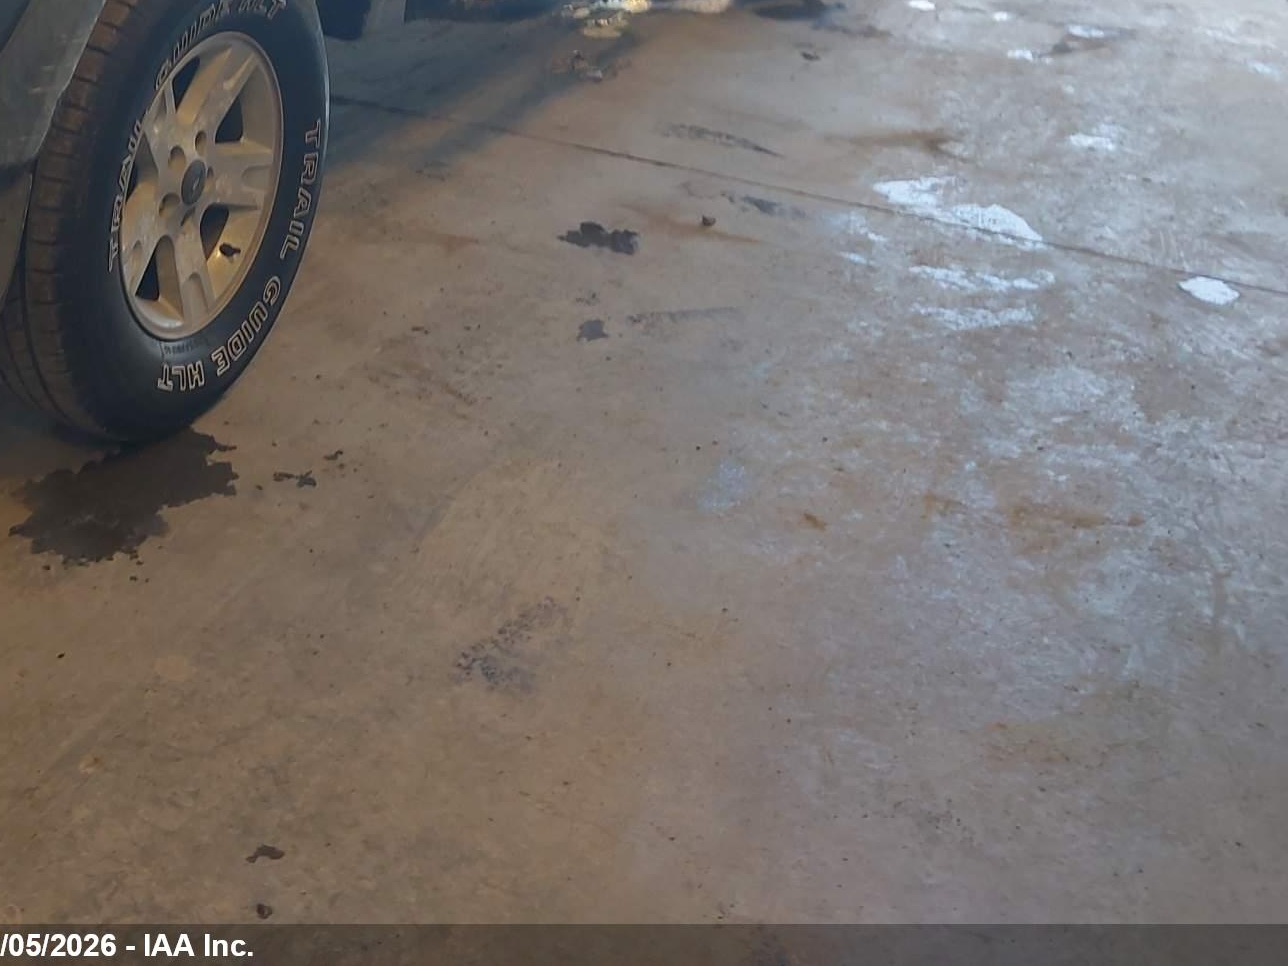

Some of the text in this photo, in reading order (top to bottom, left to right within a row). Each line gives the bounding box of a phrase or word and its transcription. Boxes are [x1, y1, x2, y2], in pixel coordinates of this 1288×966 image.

[279, 118, 322, 260] TRAIL
[157, 360, 206, 392] HLT
[211, 275, 282, 376] GUIDE
